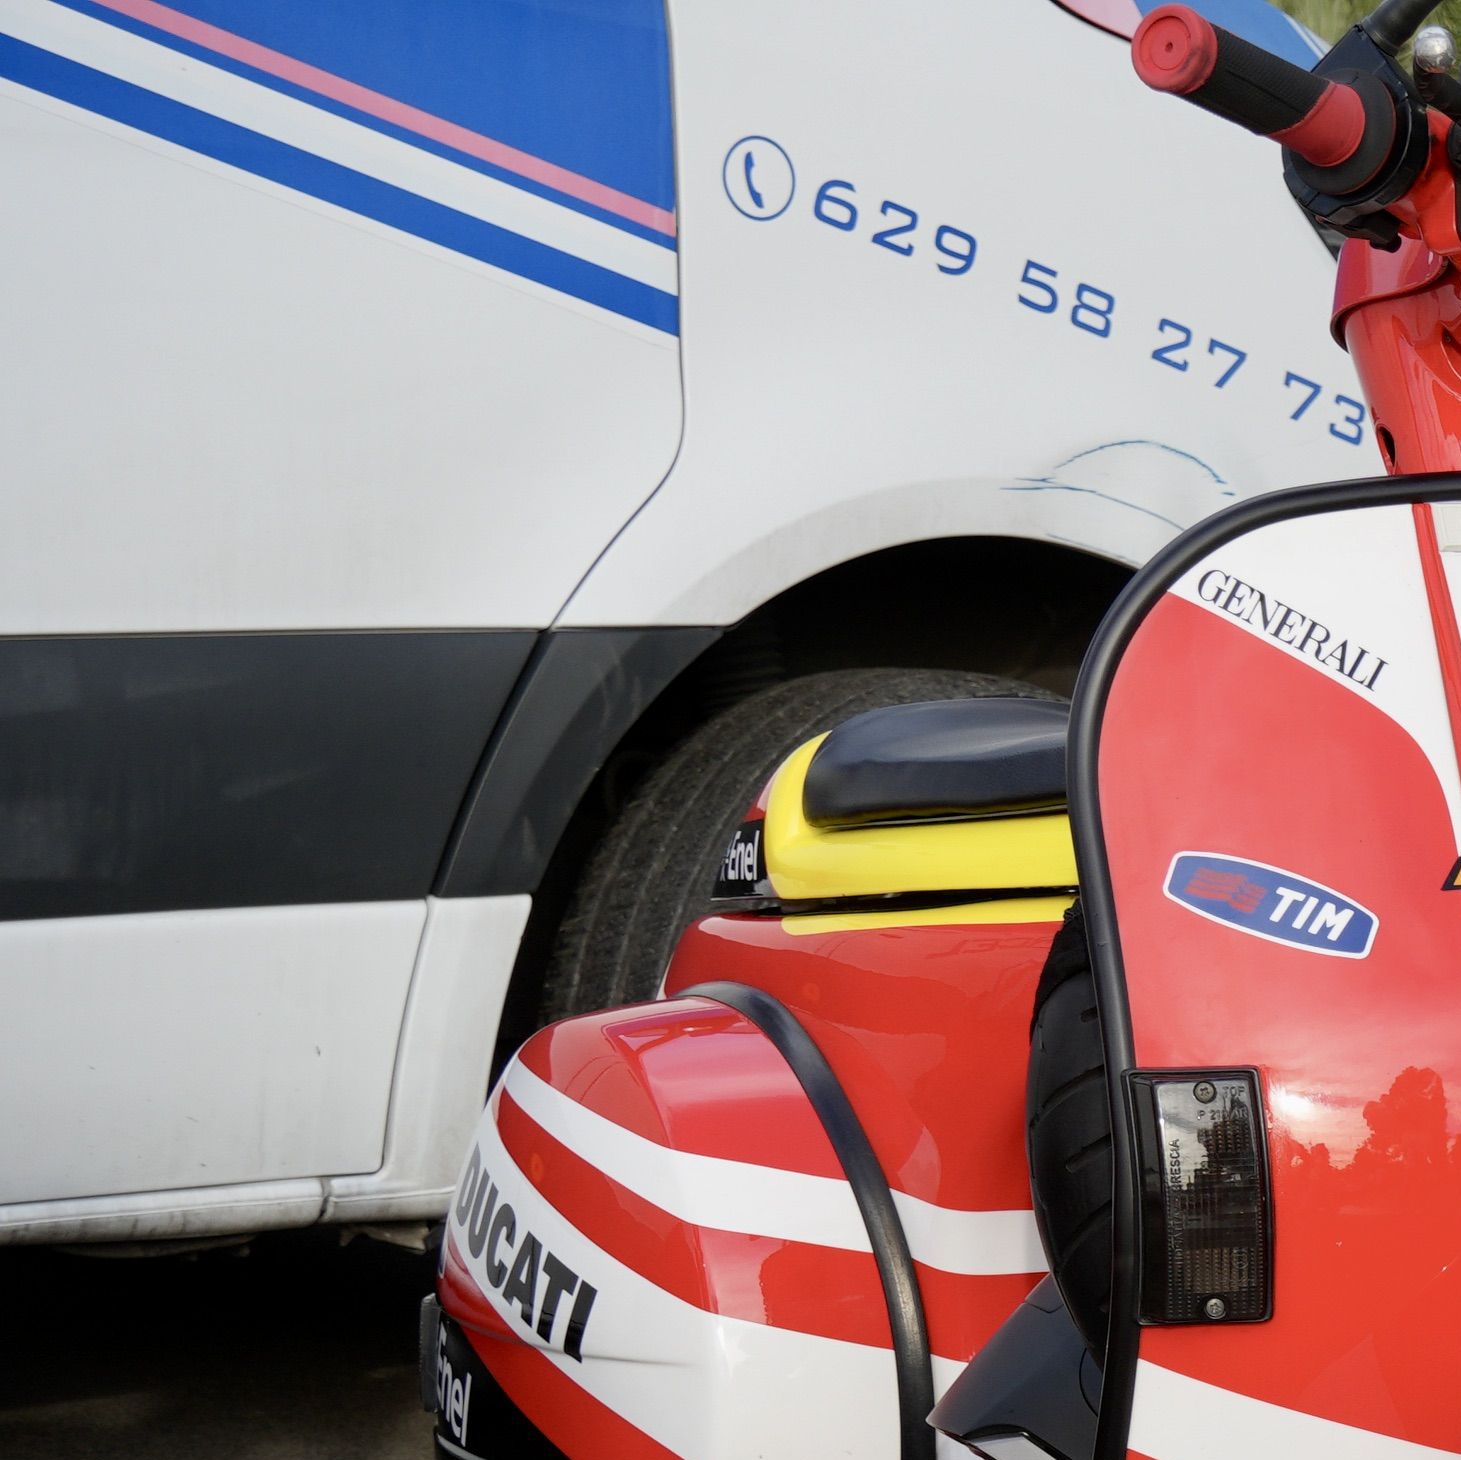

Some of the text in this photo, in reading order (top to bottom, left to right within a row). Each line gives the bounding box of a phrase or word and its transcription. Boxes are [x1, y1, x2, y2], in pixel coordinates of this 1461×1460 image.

[813, 178, 1367, 447] 629 58 27 73
[1197, 568, 1390, 692] GENERALI
[1272, 885, 1355, 942] TIM
[455, 1142, 598, 1364] DUCATI
